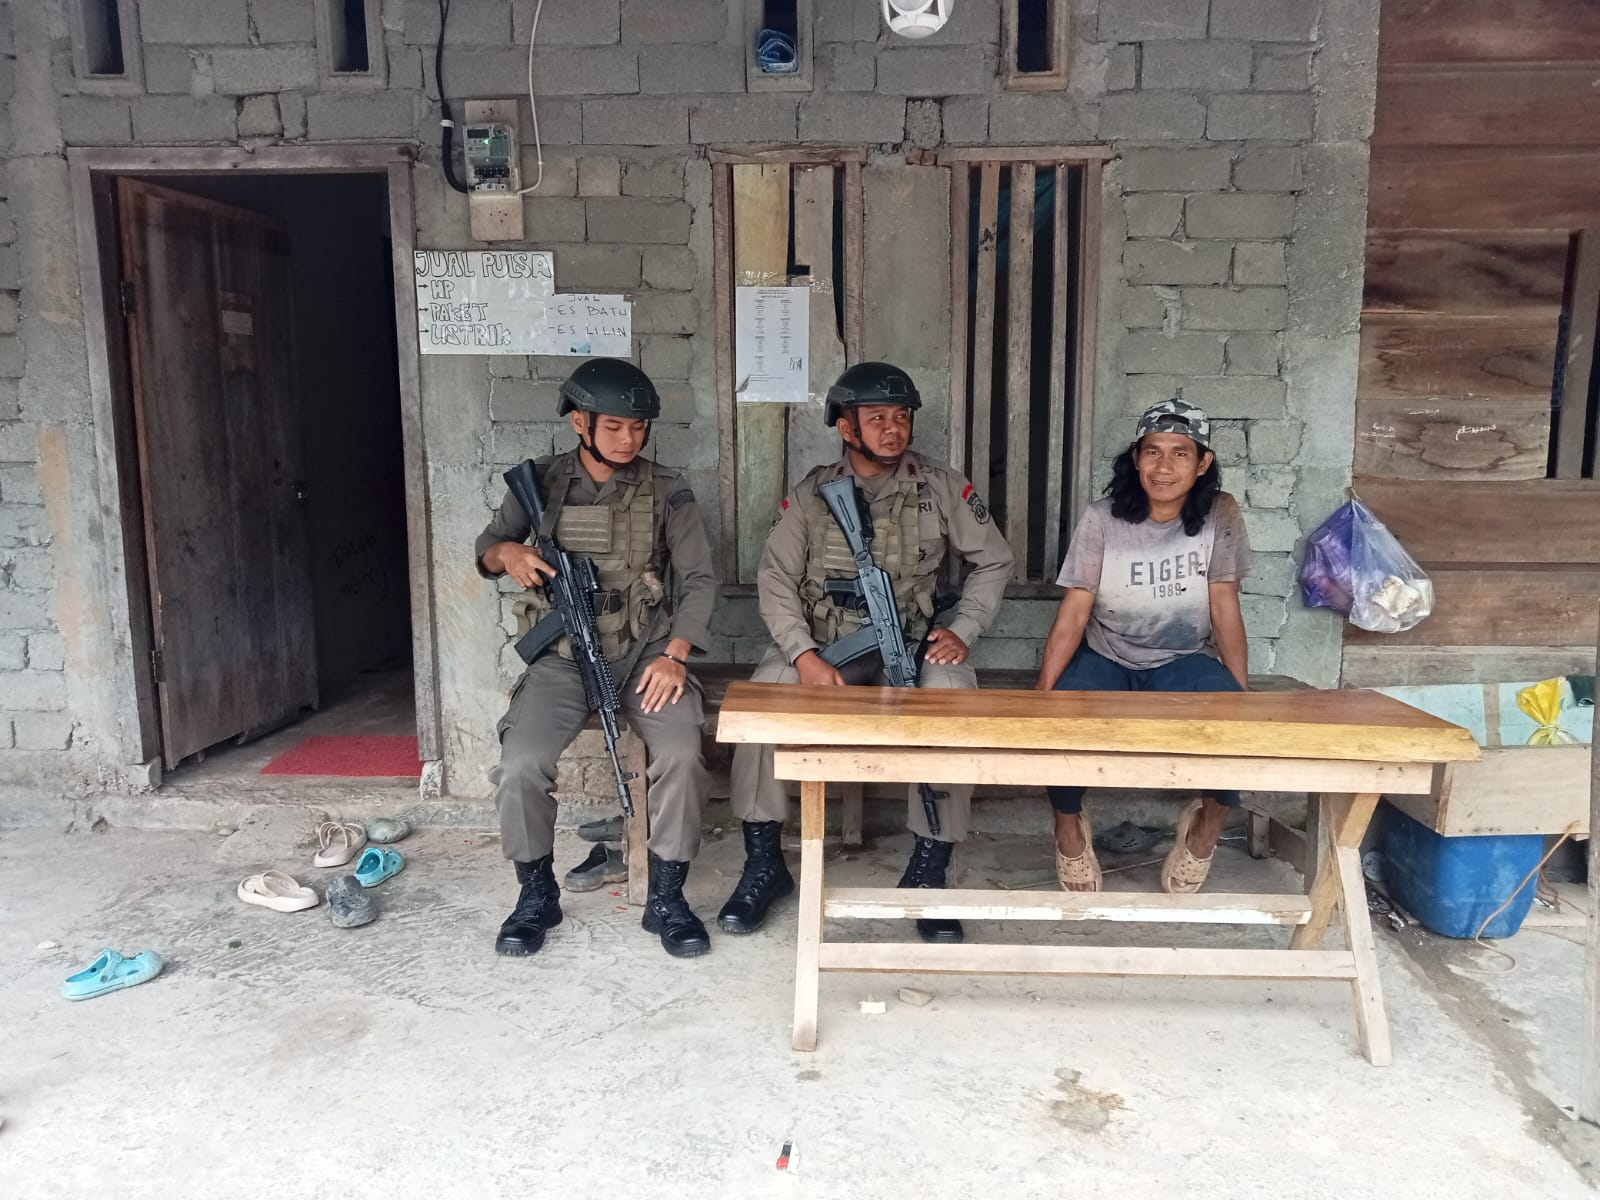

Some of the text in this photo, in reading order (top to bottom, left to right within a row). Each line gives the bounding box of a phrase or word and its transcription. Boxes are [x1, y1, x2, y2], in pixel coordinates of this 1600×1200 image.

[415, 251, 552, 279] JUAL PULSA
[431, 280, 455, 299] HP
[557, 305, 627, 316] ES BATU
[557, 324, 626, 337] ES LILIN
[918, 501, 932, 512] RI
[1130, 551, 1201, 585] EIGER
[1153, 583, 1182, 599] 1989
